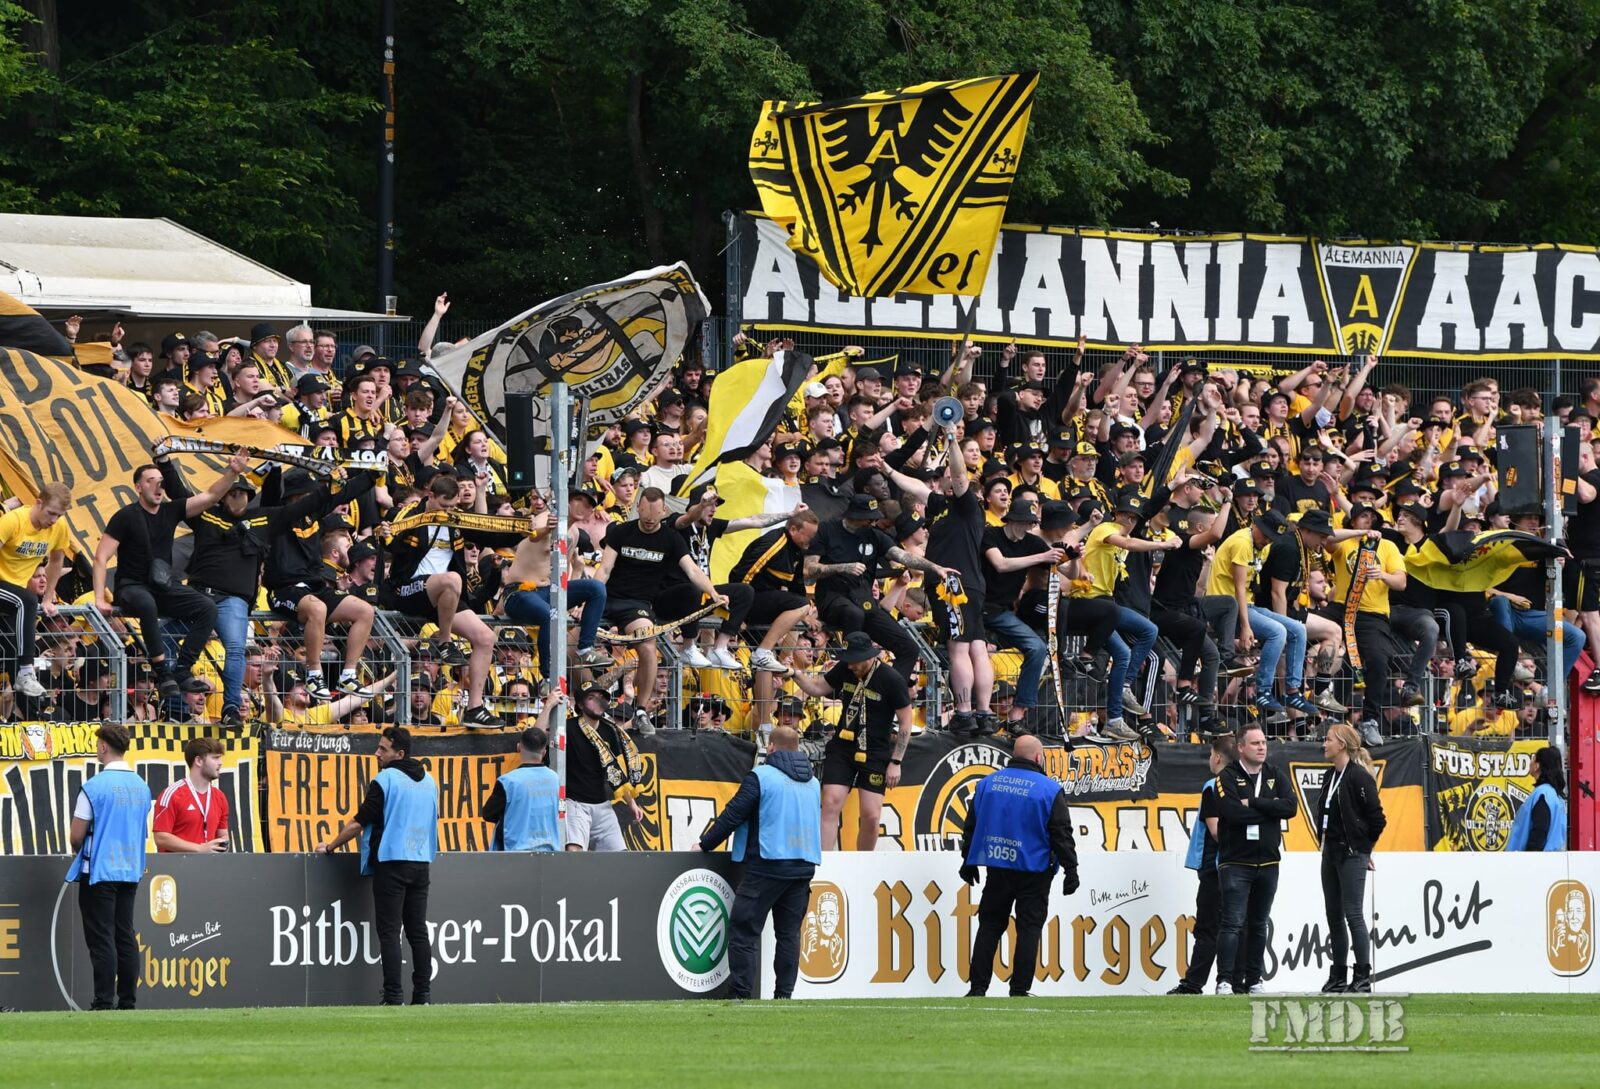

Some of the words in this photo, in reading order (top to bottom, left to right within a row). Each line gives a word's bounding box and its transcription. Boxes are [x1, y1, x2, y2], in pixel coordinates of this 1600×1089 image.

[1324, 249, 1406, 266] ALEMANNIA
[1349, 275, 1379, 318] A
[271, 732, 294, 747] Für
[295, 732, 314, 749] die
[1044, 743, 1134, 781] ULTRAS
[1433, 744, 1476, 777] FÜR
[991, 783, 1029, 797] SERVICE
[992, 774, 1036, 788] SECURITY
[669, 873, 730, 900] FUSSBALL-VERBAND
[1090, 888, 1113, 906] Bitte
[1131, 879, 1149, 895] Bit
[1423, 879, 1494, 940] Bit
[269, 898, 622, 982] Bitbuger-Pokal
[677, 968, 722, 988] MITTELRHEIN
